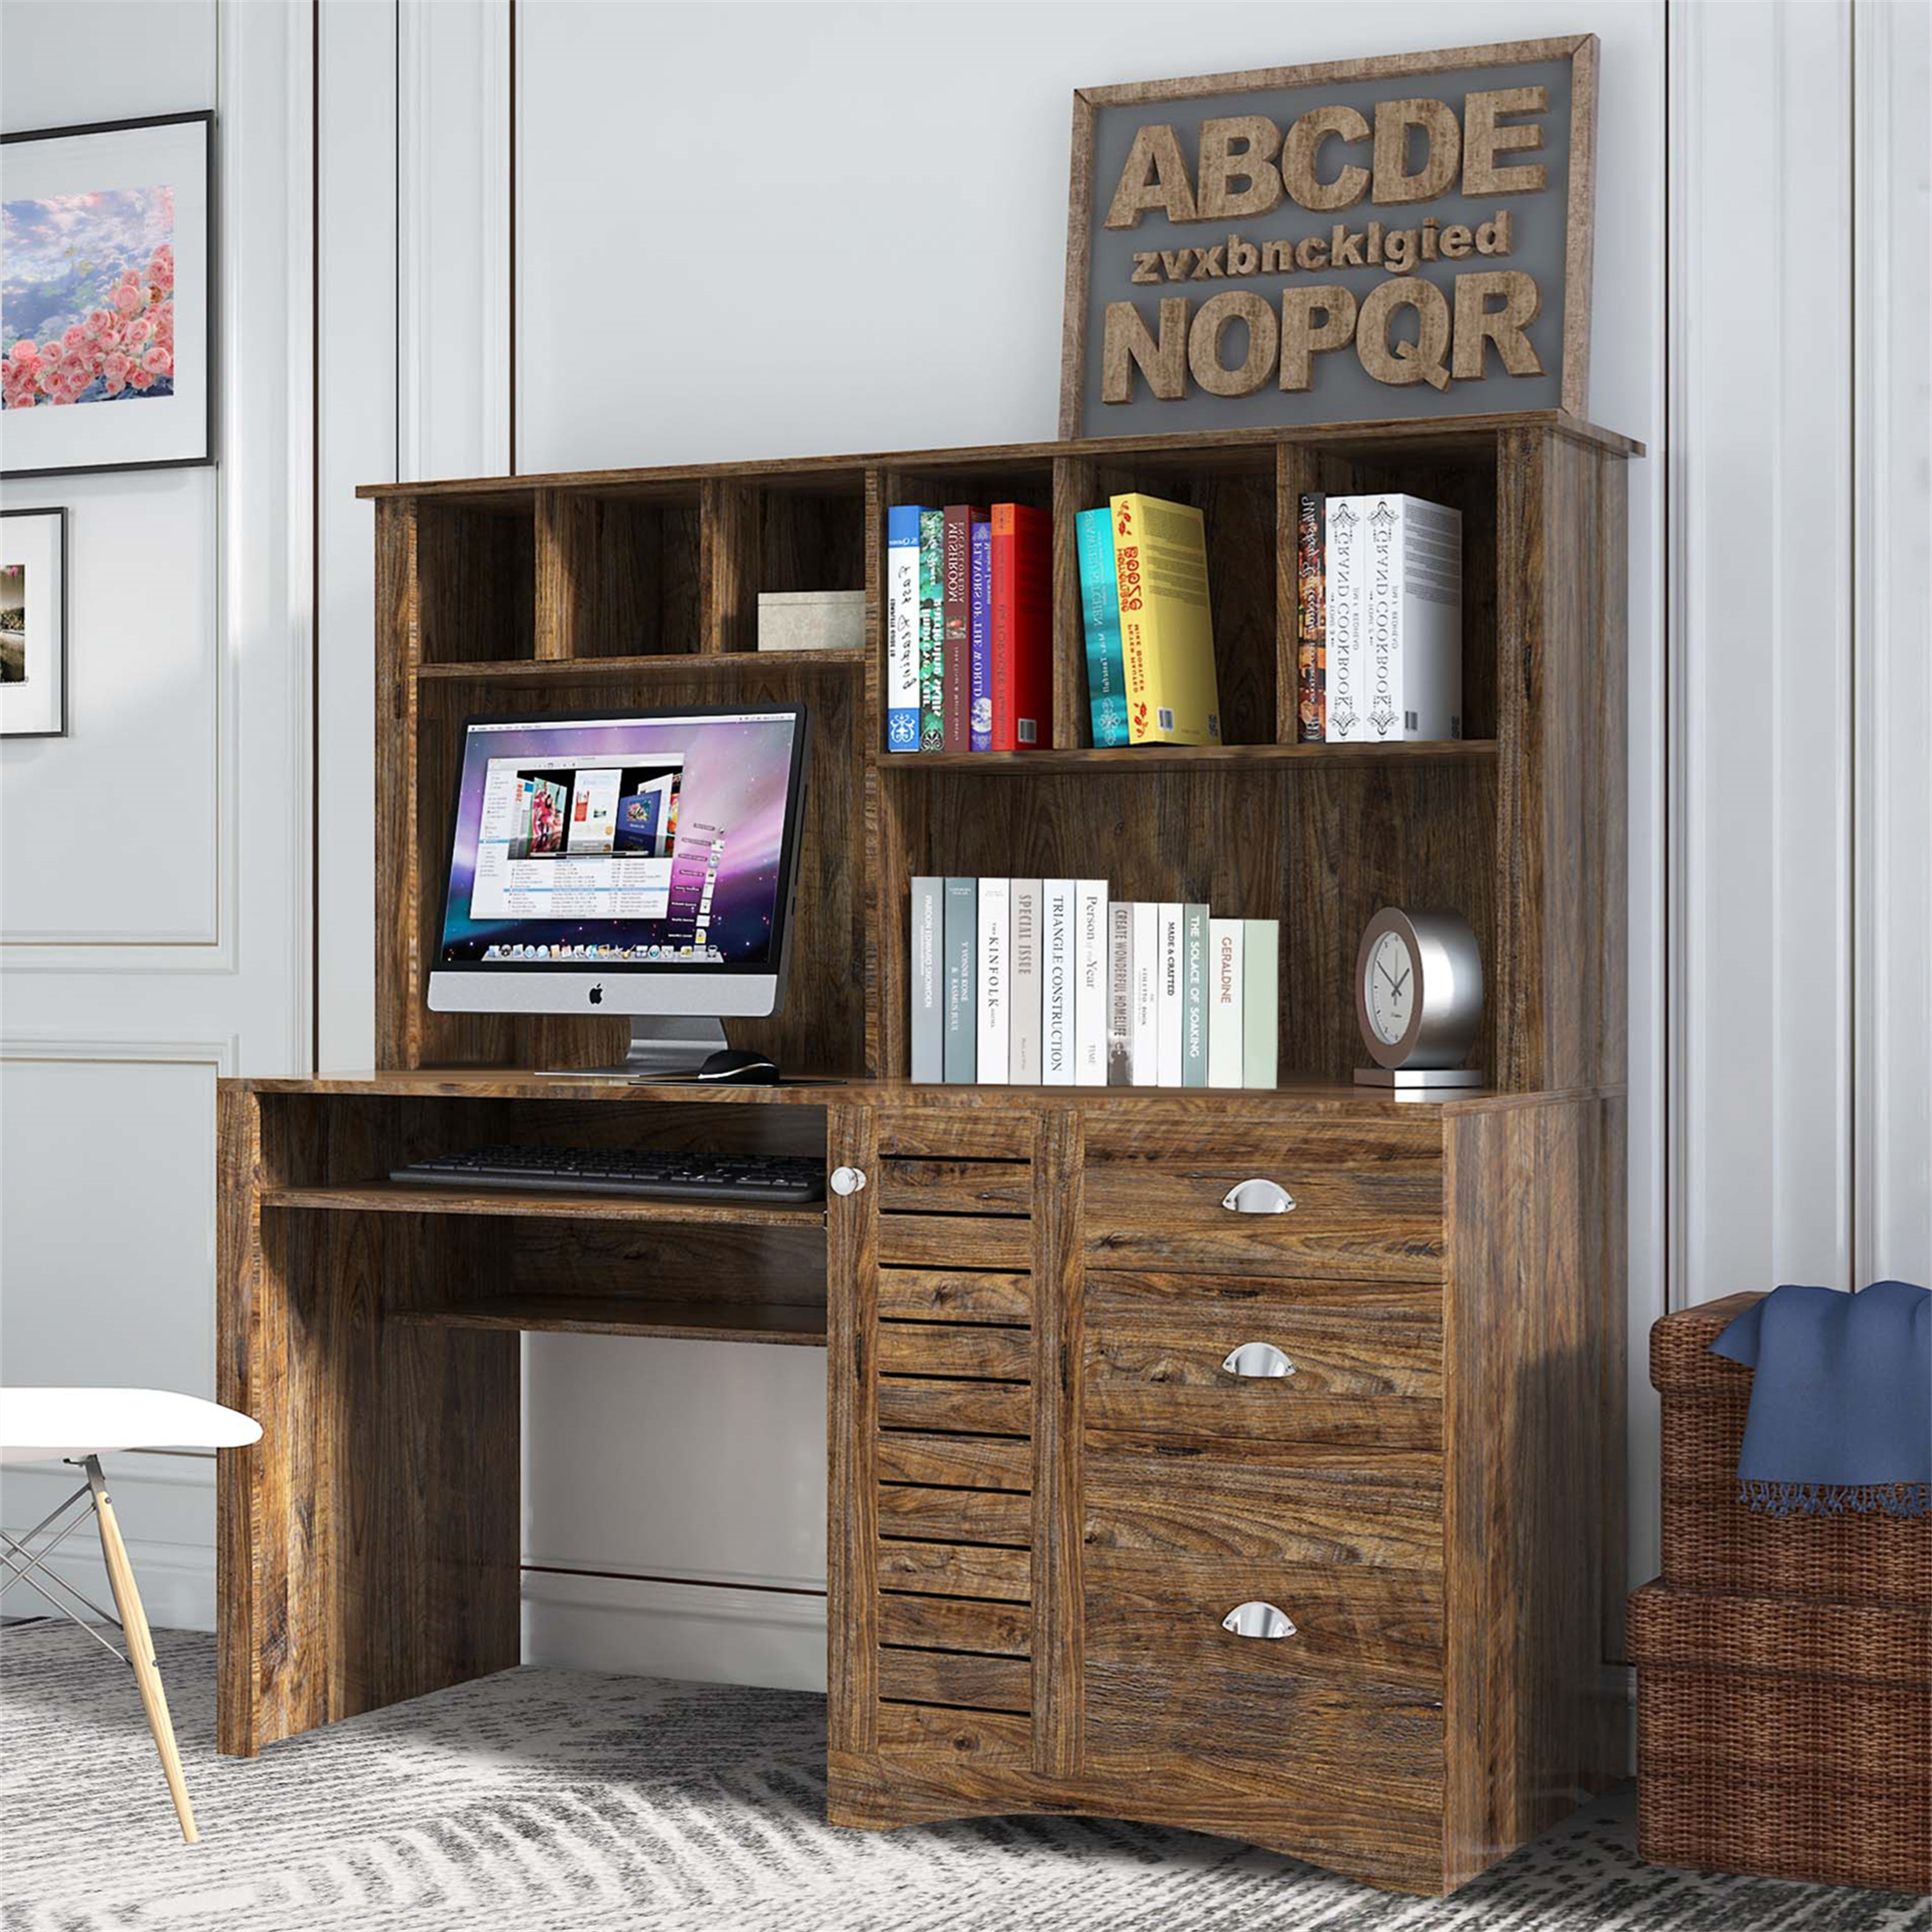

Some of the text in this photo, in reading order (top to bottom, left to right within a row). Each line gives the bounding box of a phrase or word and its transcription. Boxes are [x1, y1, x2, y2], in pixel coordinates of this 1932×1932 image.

[1104, 86, 1549, 230] ABCDE
[1132, 209, 1513, 285] zvxbncklgied
[1101, 270, 1548, 404] NOPQR
[1019, 894, 1032, 939] SPECIAL
[1086, 896, 1098, 940] Person
[988, 936, 999, 1007] KINFOLK
[1050, 895, 1064, 1071] TRIANGLE CONSTRUCTION
[1086, 961, 1098, 988] Year
[1114, 910, 1128, 1037] CREATE WONDERFUL HOMELIFE
[1166, 956, 1175, 996] CRAFTED
[1189, 915, 1200, 1058] THE SOLACE OF SOAKING
[1221, 937, 1232, 1004] GERALDINE
